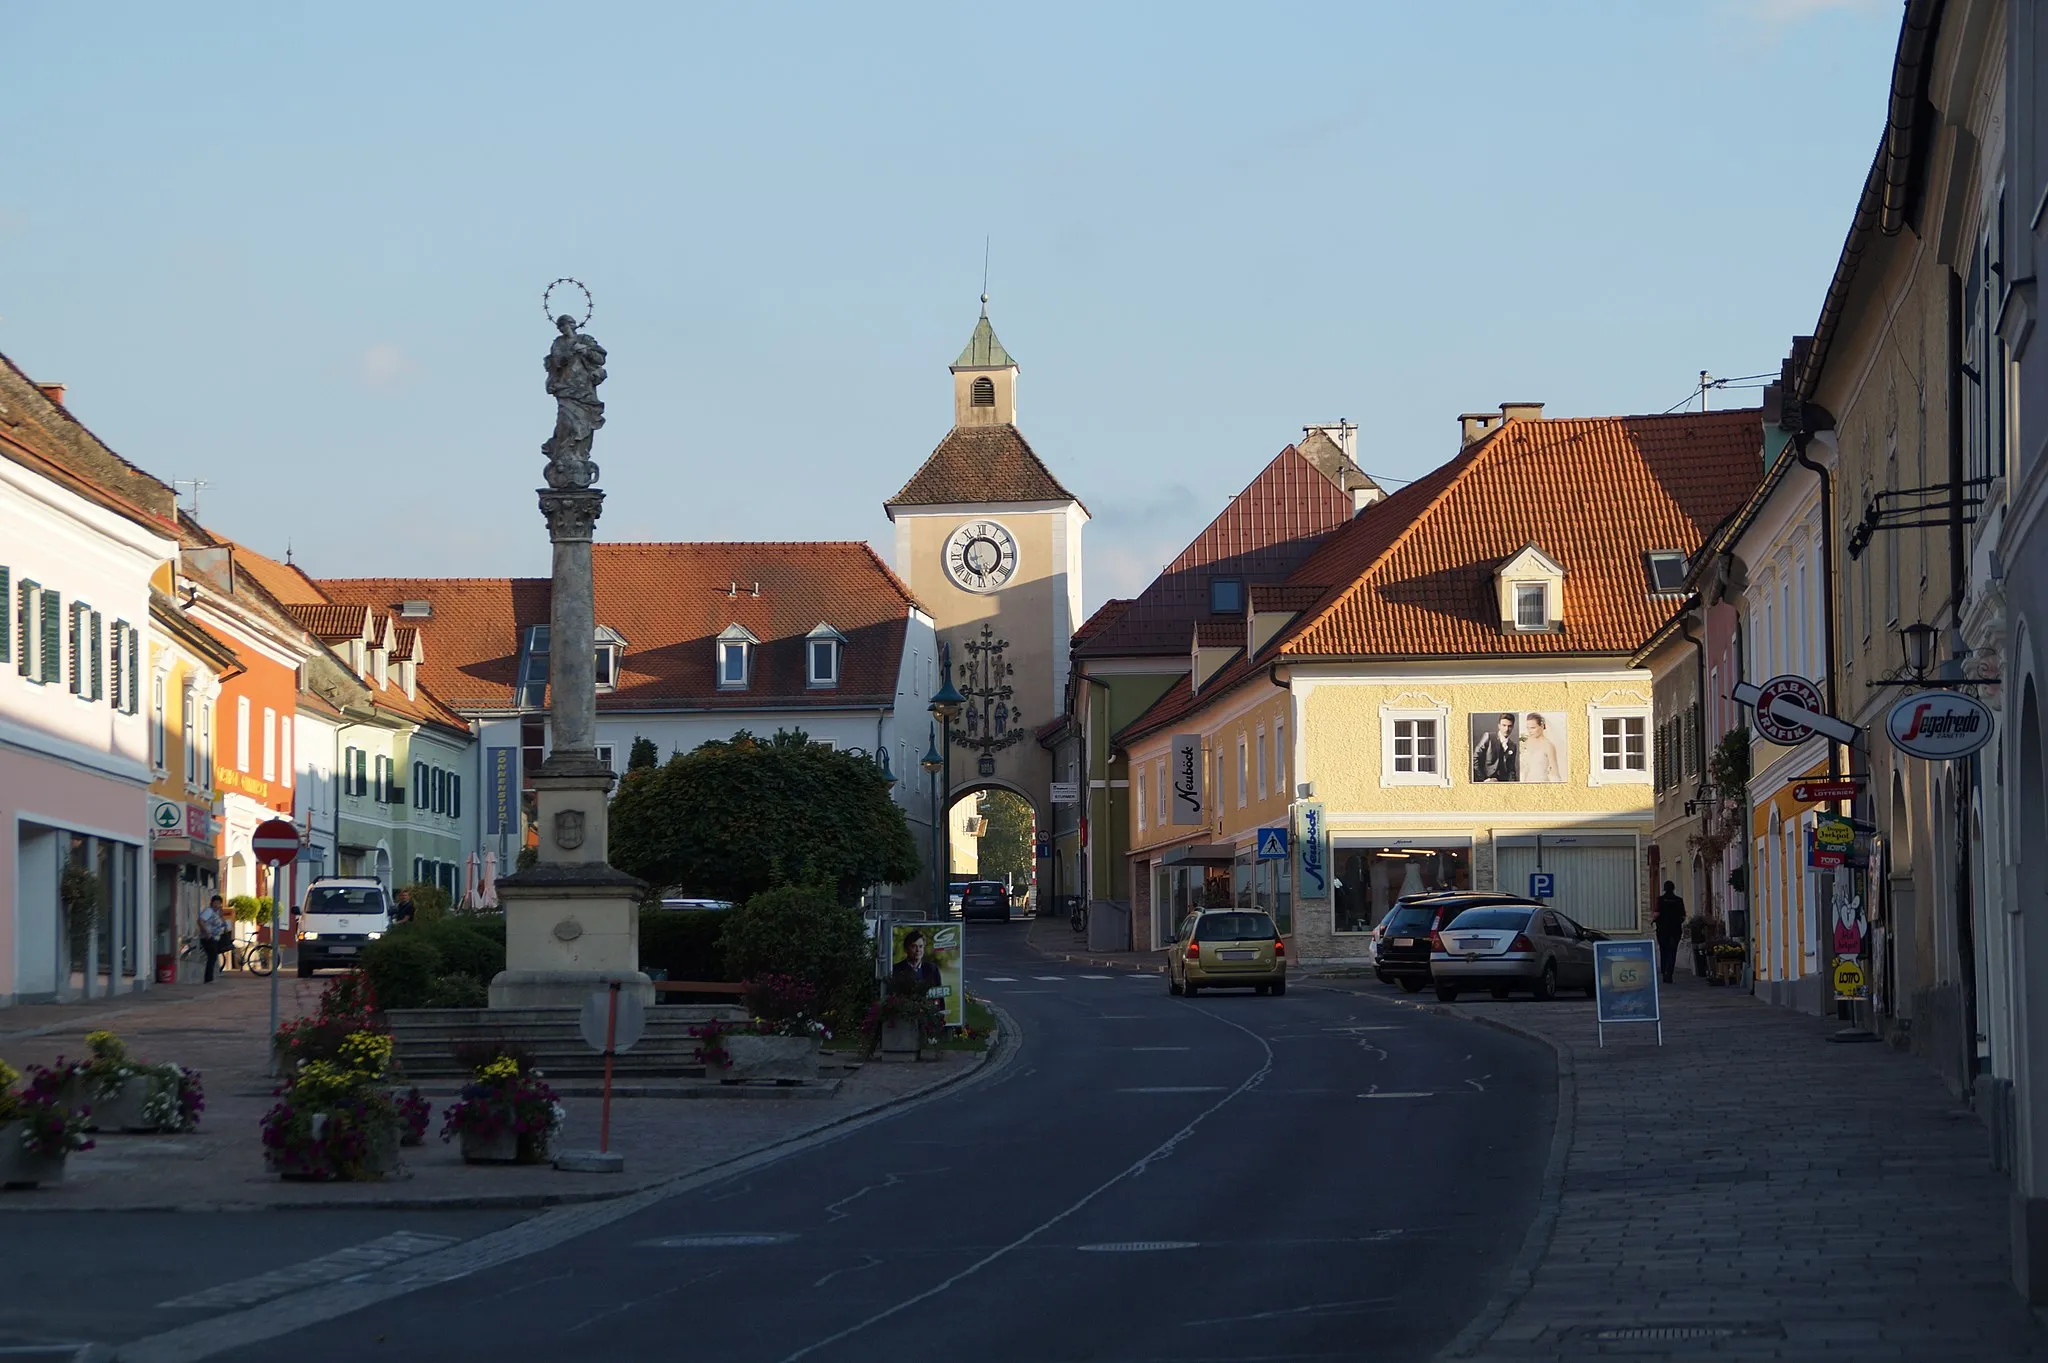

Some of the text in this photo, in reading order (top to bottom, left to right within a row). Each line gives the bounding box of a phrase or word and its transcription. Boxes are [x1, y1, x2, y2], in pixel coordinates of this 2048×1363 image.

[1767, 682, 1818, 707] TABAK
[1759, 706, 1806, 740] TRAFIK
[1901, 703, 1980, 741] Segafredo
[497, 749, 507, 820] SONNENSTUD
[1175, 746, 1201, 812] Neuböck
[1820, 831, 1849, 840] Jackpot
[1302, 809, 1325, 890] Neuböck
[1821, 856, 1840, 864] TOTO
[1535, 875, 1550, 896] P
[1619, 968, 1638, 983] 65
[1838, 971, 1860, 983] LOTTO
